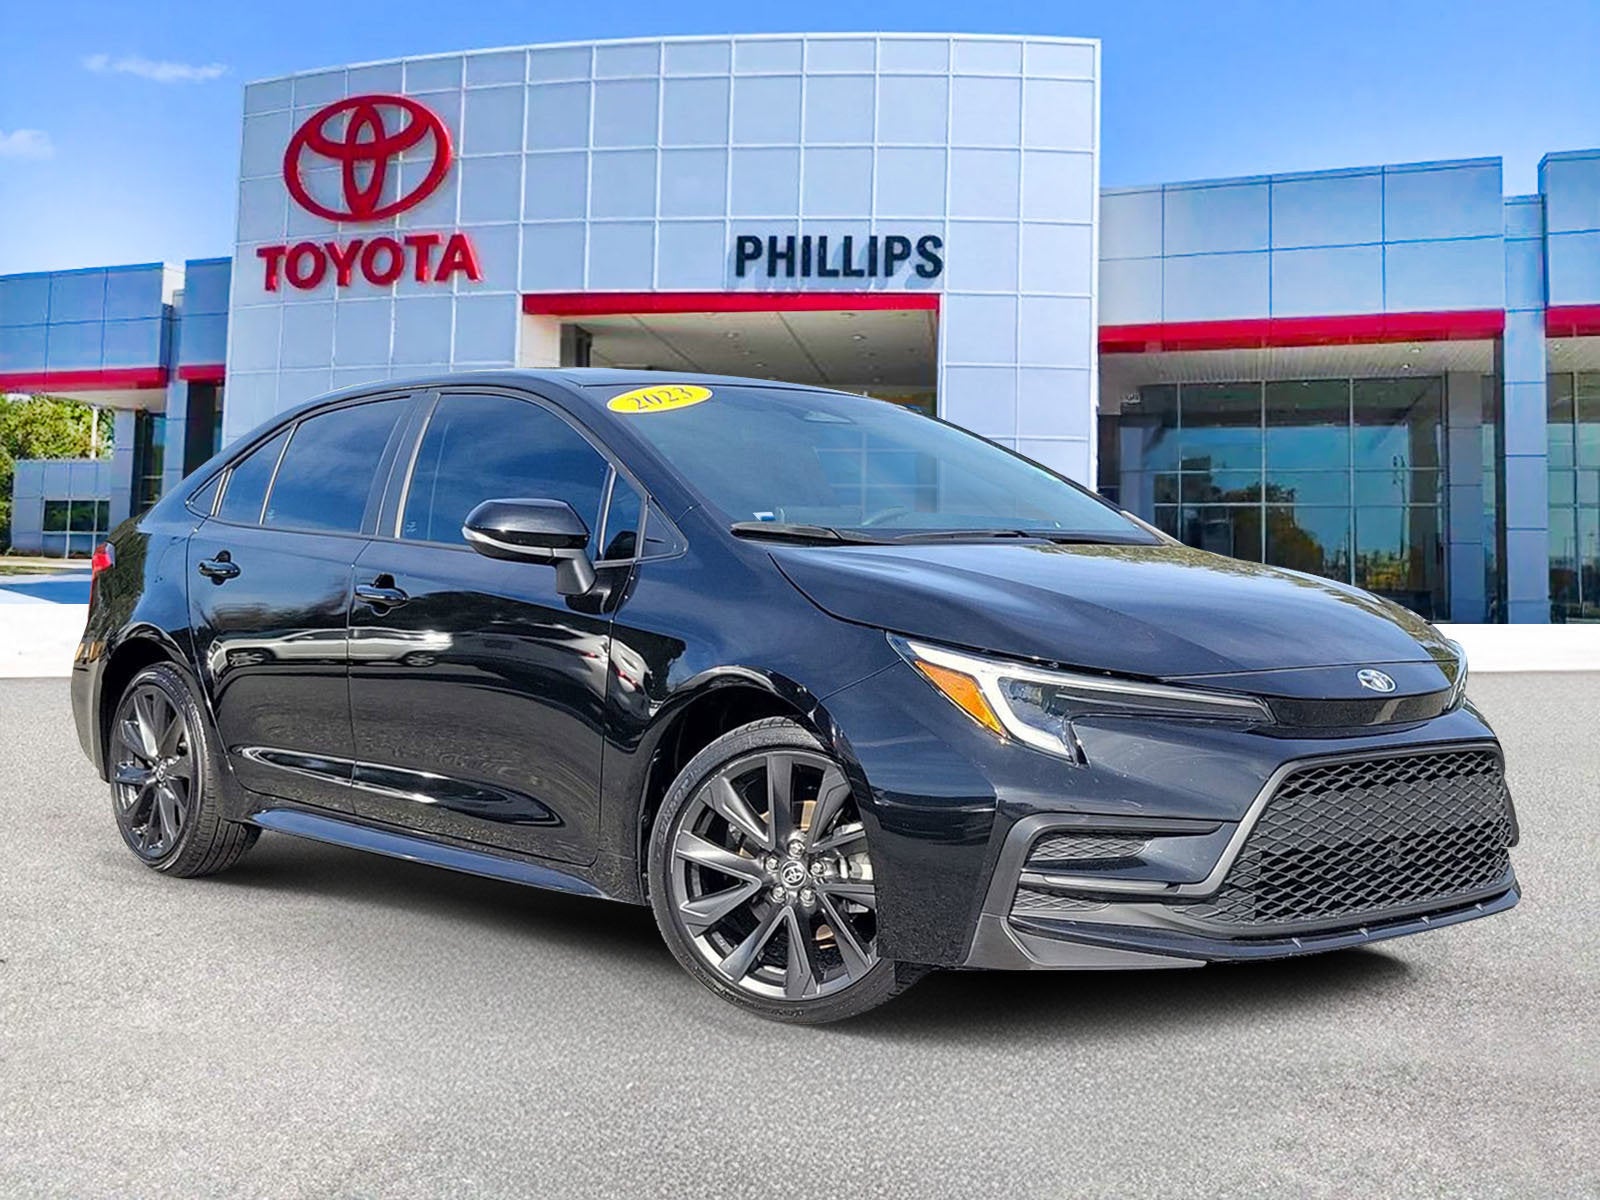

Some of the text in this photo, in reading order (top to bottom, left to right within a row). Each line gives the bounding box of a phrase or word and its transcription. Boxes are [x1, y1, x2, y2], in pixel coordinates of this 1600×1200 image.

[256, 233, 482, 292] TOYOTA
[735, 235, 943, 278] PHILLIPS
[627, 387, 693, 410] 2023
